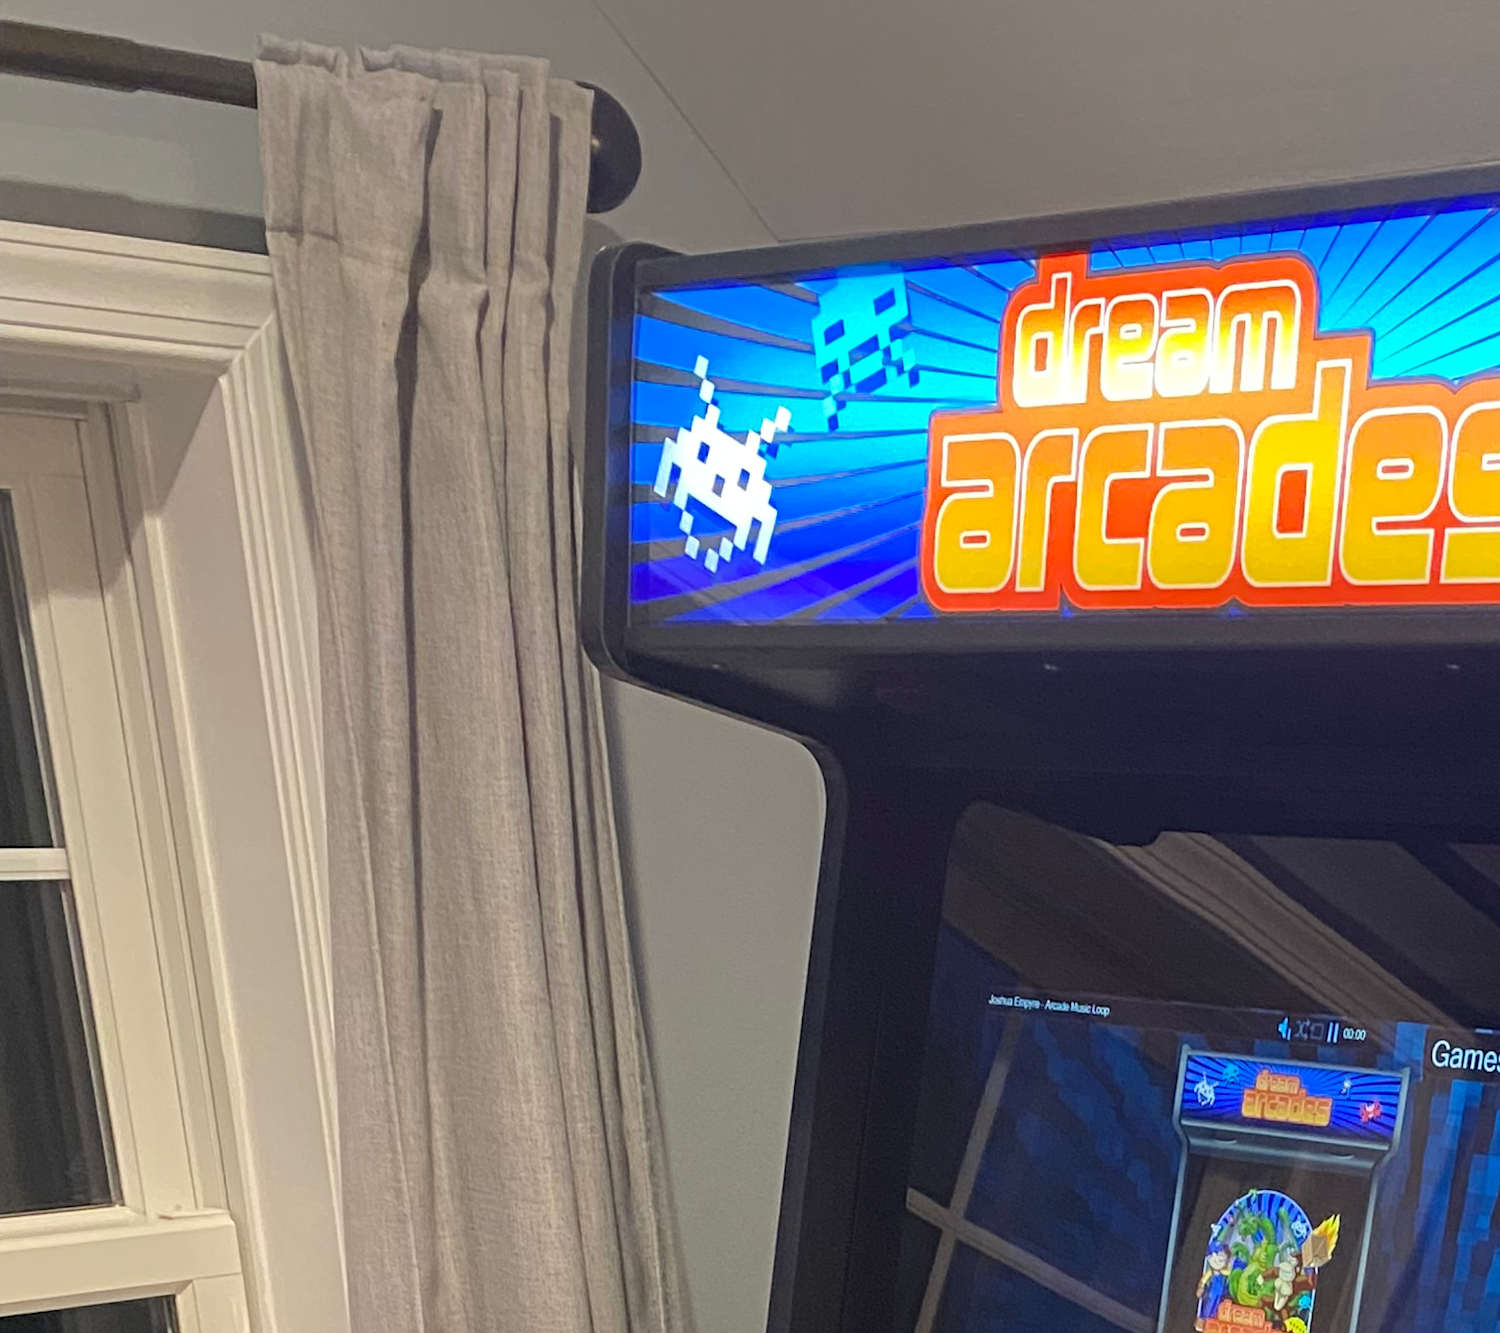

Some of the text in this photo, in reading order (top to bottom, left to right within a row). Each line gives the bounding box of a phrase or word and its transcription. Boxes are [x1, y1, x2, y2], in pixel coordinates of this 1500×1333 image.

[1011, 271, 1302, 408] dream
[1044, 999, 1070, 1012] Arcade
[1070, 1001, 1091, 1014] Music
[1091, 1004, 1111, 1018] Loop
[1342, 1027, 1367, 1041] 00:00
